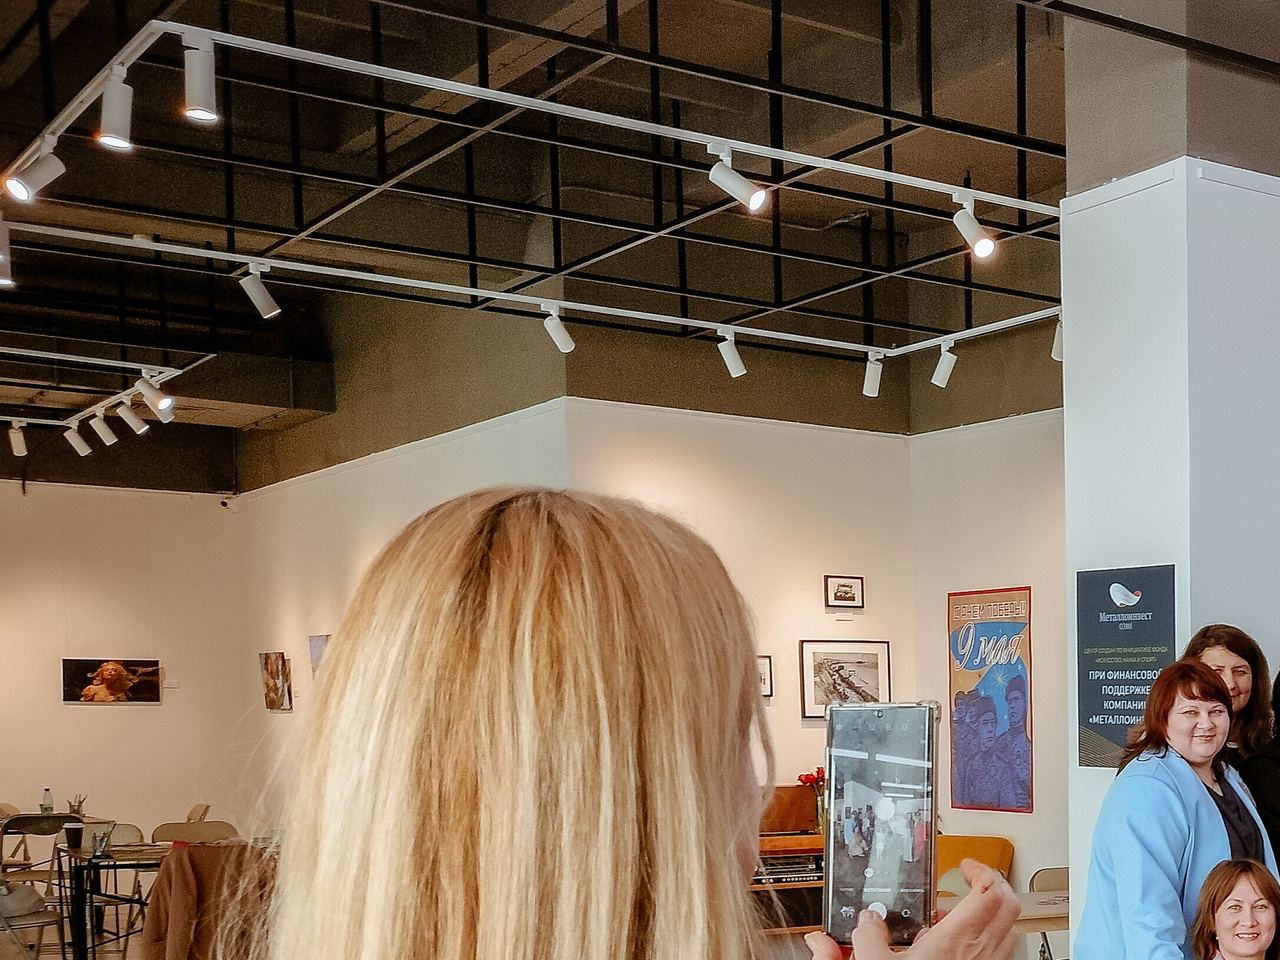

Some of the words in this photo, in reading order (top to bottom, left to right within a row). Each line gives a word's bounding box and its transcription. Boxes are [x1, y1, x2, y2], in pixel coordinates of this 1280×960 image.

[1098, 612, 1153, 622] Металлоинвест
[955, 621, 975, 671] 9
[973, 635, 1024, 665] мая
[1089, 671, 1105, 680] ПРИ
[1102, 685, 1151, 696] ПОДДЕРЖКЕ
